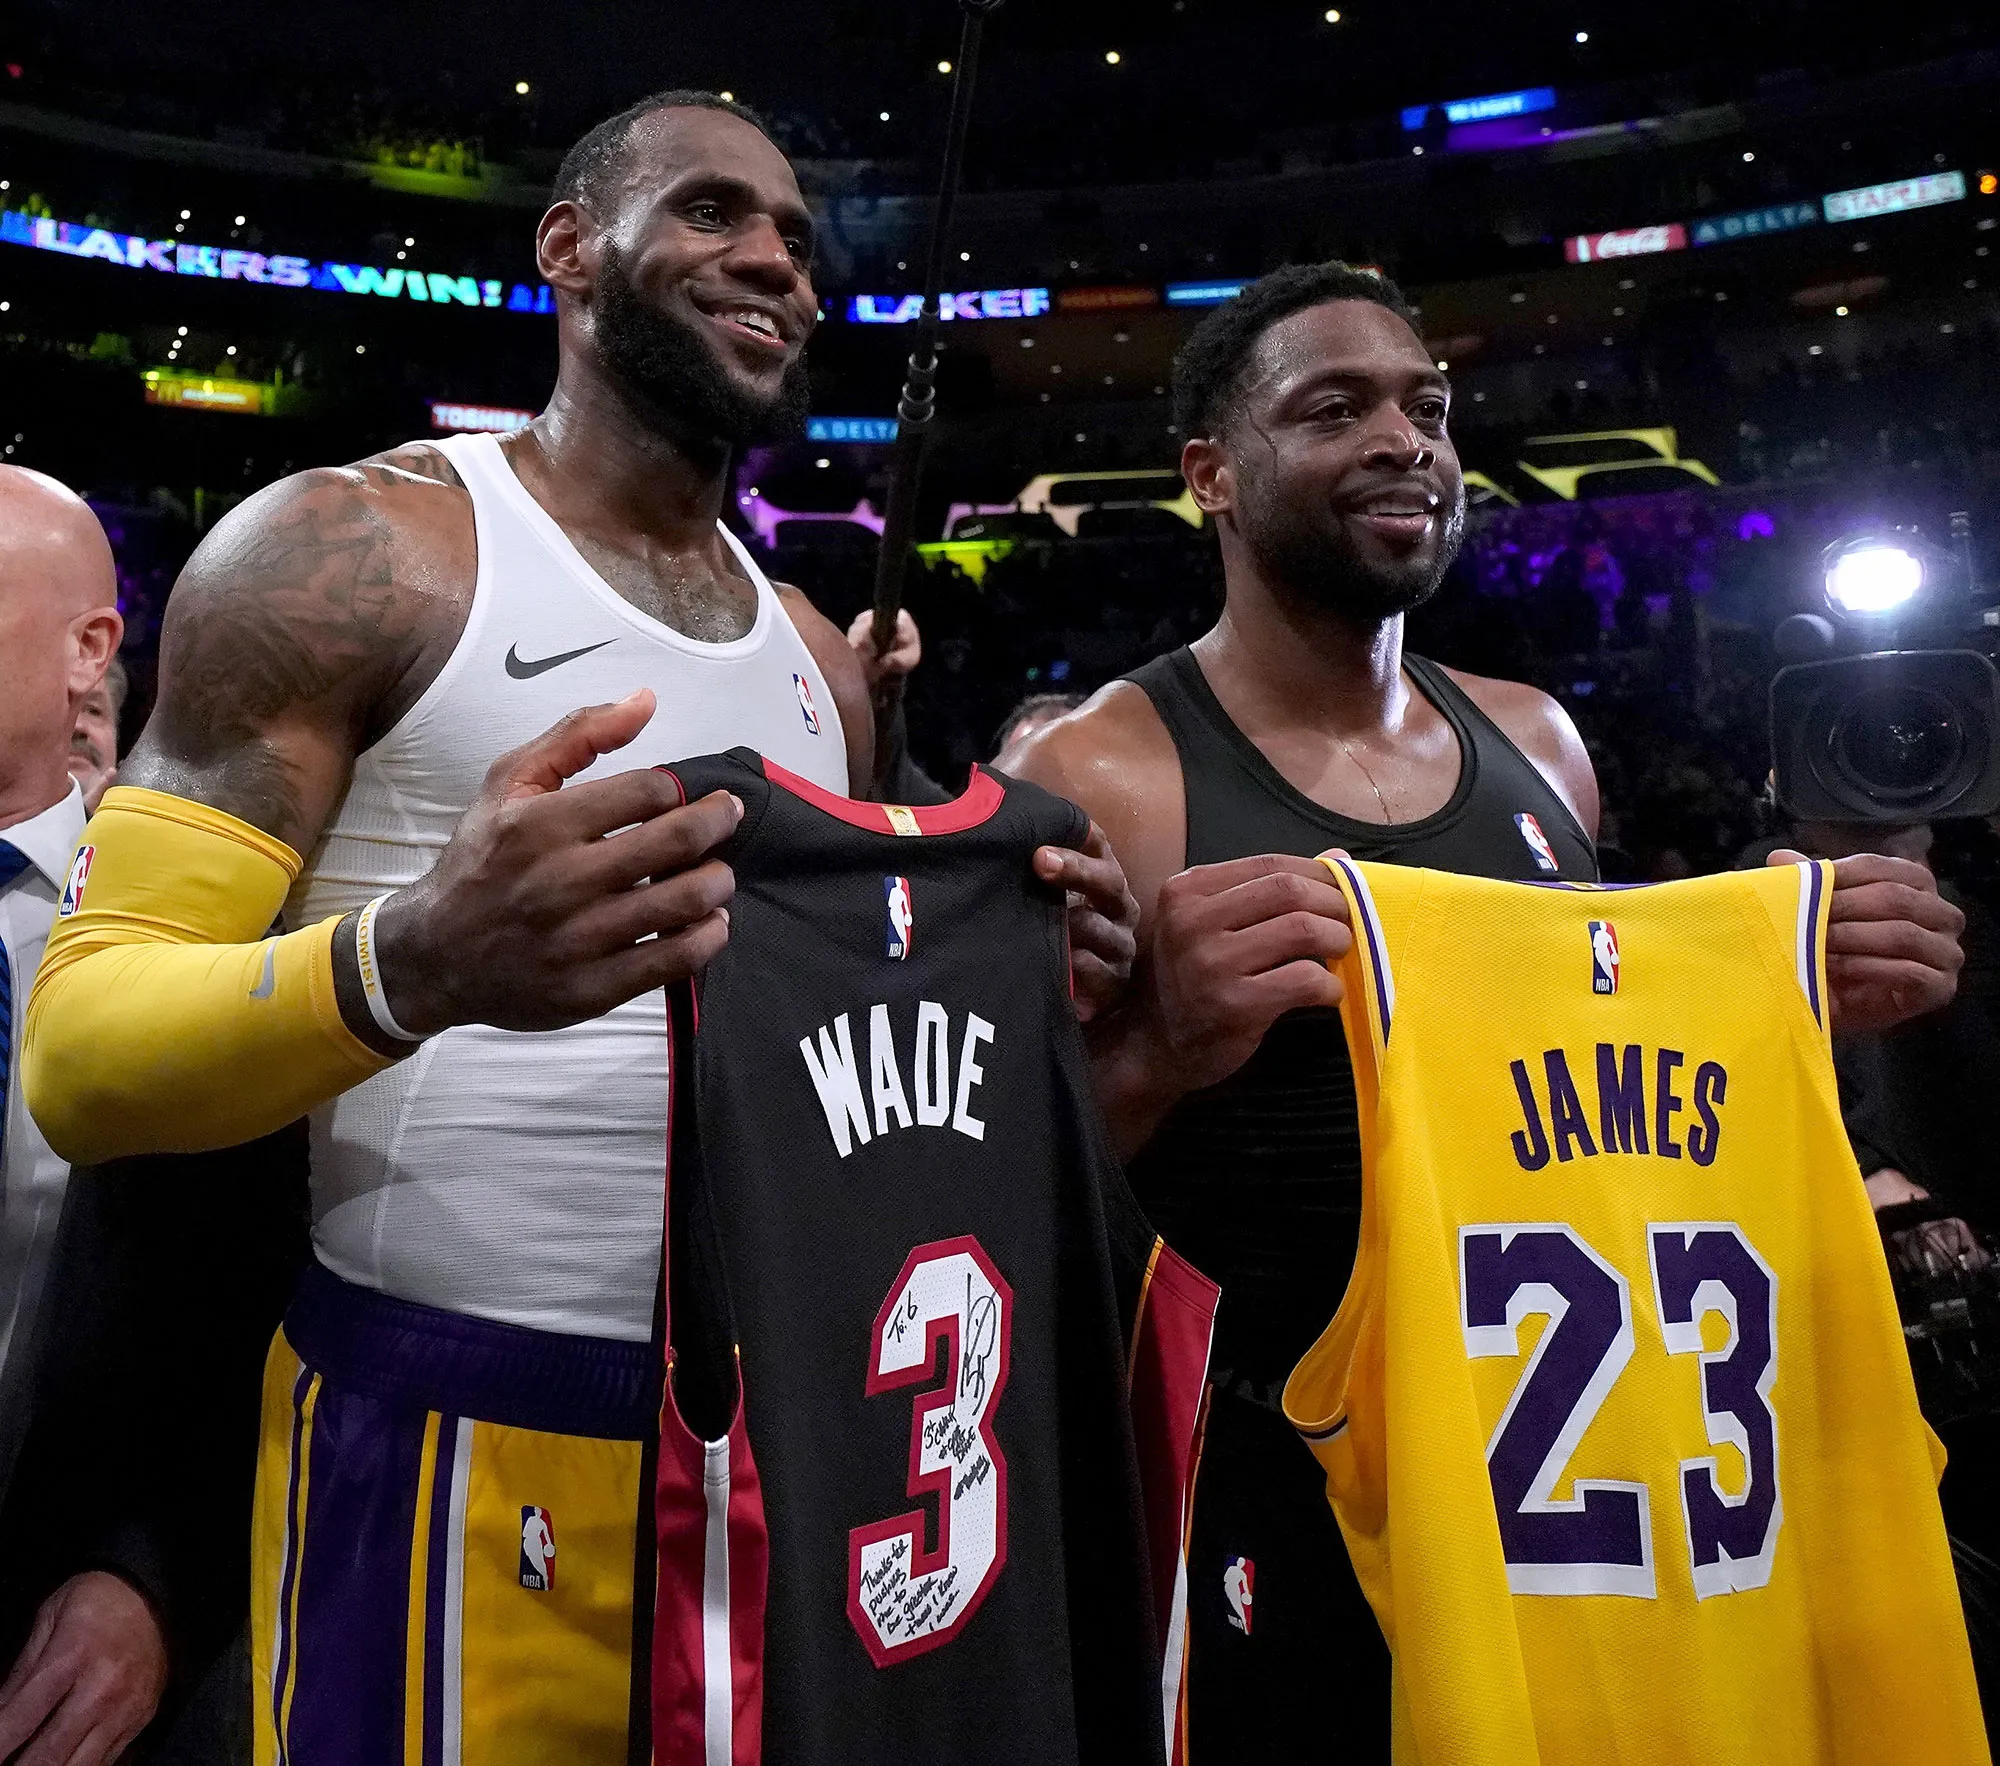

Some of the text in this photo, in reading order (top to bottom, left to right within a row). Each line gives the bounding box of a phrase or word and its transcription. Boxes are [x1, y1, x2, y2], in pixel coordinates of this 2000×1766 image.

[36, 218, 502, 307] LAKERS WIN!
[1723, 203, 1818, 237] DELTA
[1595, 978, 1610, 992] NBA
[799, 1000, 996, 1158] WADE
[1509, 1043, 1728, 1172] JAMES
[847, 1234, 1014, 1669] 3
[1458, 1222, 1784, 1601] 23
[523, 1574, 541, 1588] NBA
